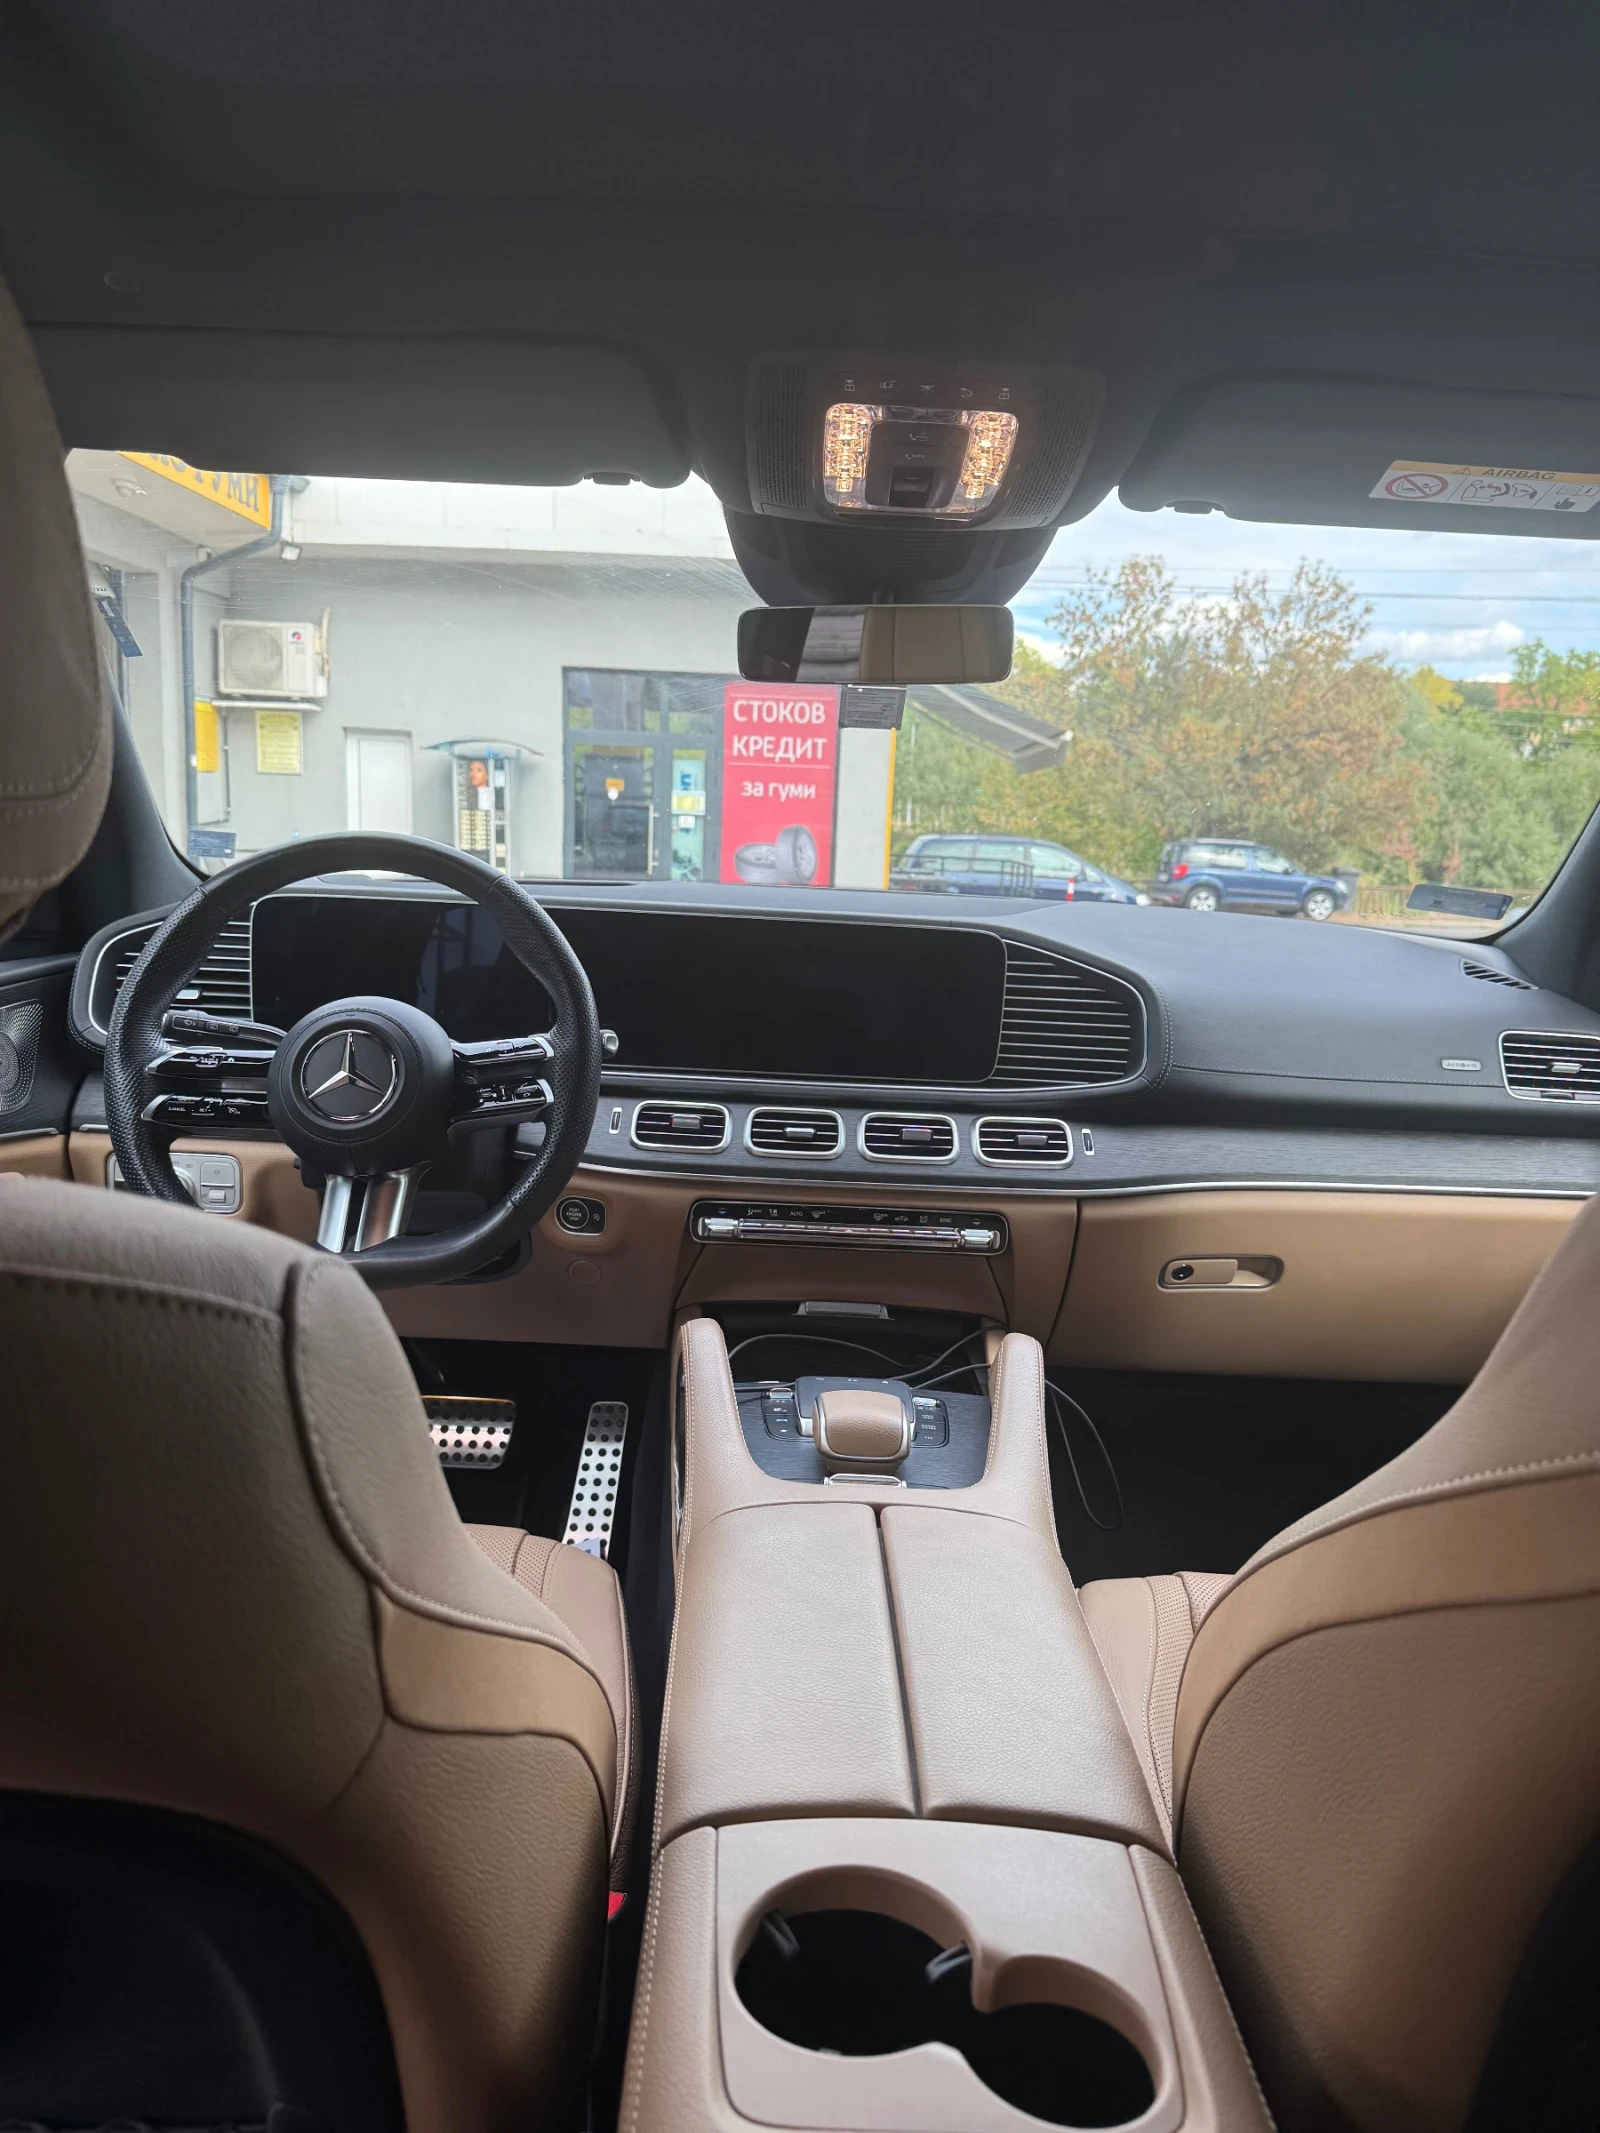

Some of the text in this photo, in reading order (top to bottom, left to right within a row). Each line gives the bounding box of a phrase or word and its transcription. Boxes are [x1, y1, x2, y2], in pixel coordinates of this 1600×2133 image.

[1482, 468, 1556, 480] AIRBAG
[733, 699, 826, 724] СТОКОВ
[732, 735, 828, 763] КРЕДИТ
[741, 781, 817, 803] за гуми
